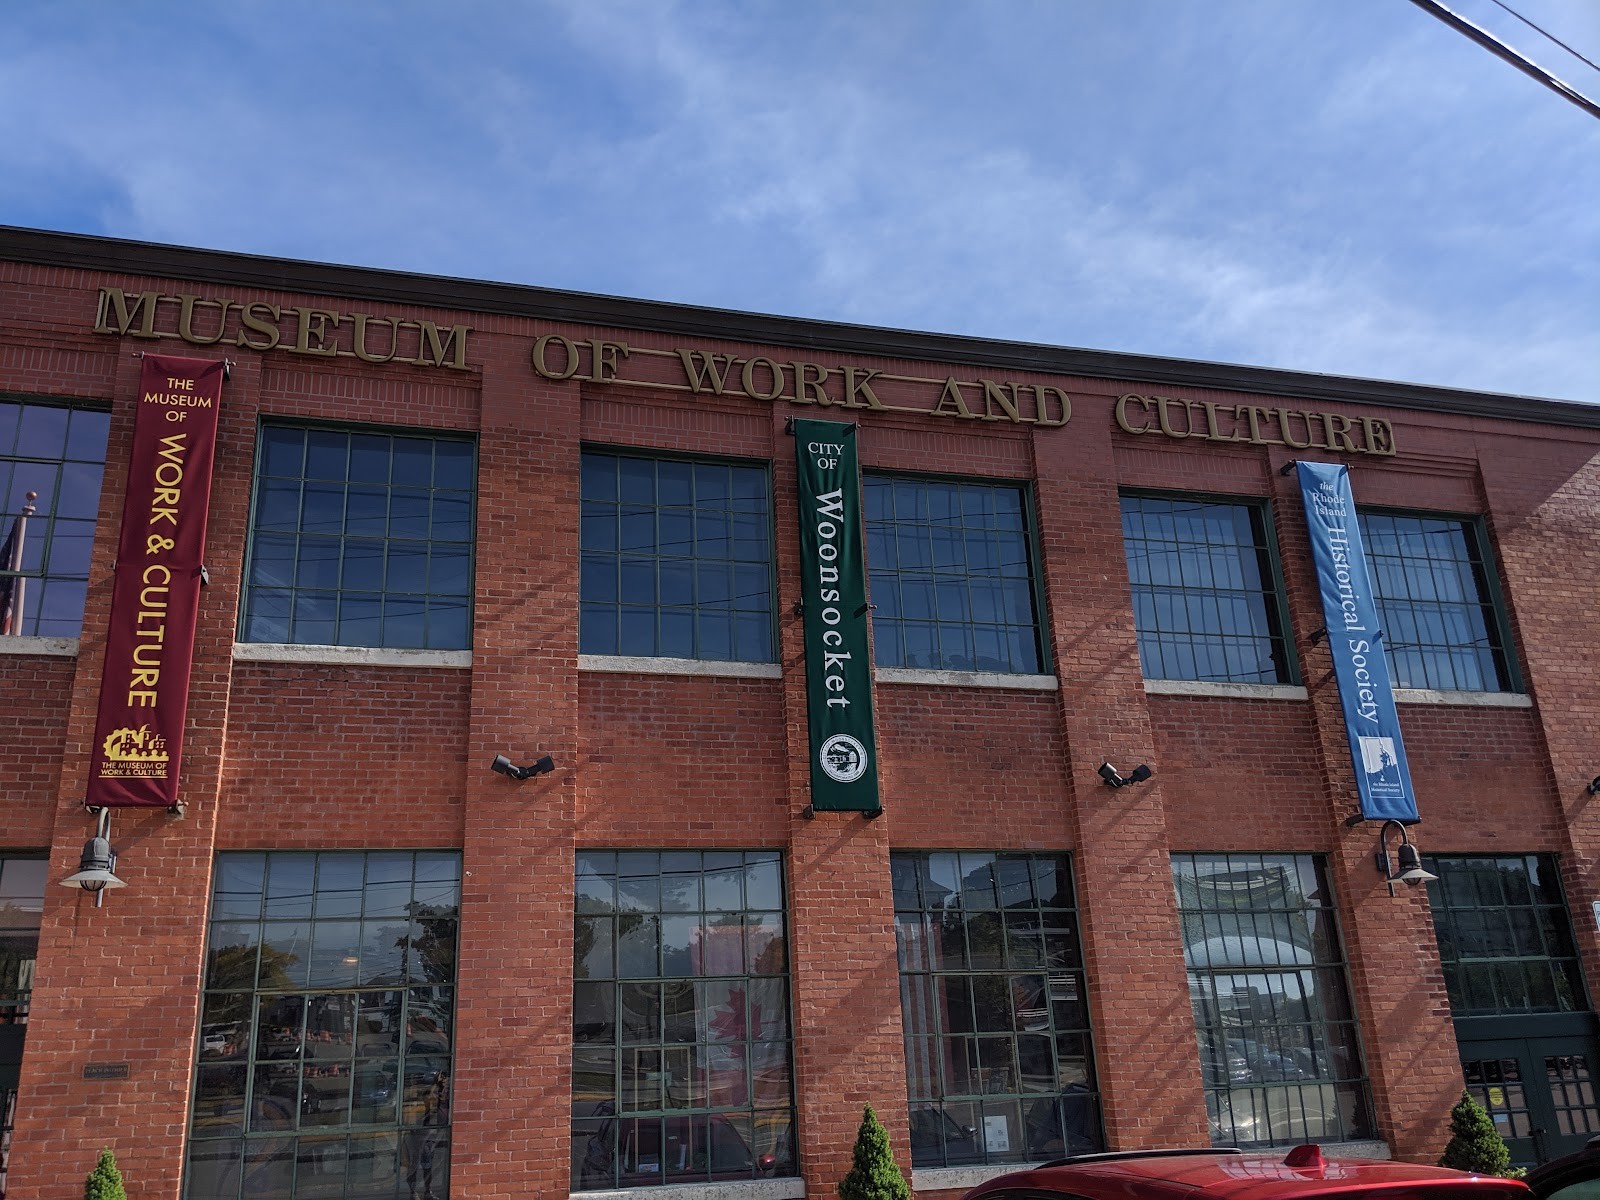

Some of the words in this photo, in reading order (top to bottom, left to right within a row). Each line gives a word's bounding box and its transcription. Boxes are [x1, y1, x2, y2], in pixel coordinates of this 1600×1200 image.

[93, 287, 474, 371] MUSEUM
[532, 334, 629, 384] OF
[674, 348, 889, 412] WORK
[930, 376, 1072, 427] AND
[1115, 393, 1397, 456] CULTURE
[167, 377, 195, 391] THE
[144, 392, 212, 408] MUSEUM
[165, 410, 187, 422] OF
[808, 442, 845, 455] CITY
[817, 457, 838, 470] OF
[150, 433, 187, 526] WORK
[1320, 481, 1334, 491] the
[1312, 492, 1345, 504] Rhode
[1315, 504, 1347, 517] Island
[146, 534, 175, 555] &
[815, 487, 852, 708] Woonsocket
[1328, 526, 1367, 632] Historical
[1348, 639, 1380, 724] Society
[127, 564, 171, 708] CULTURE
